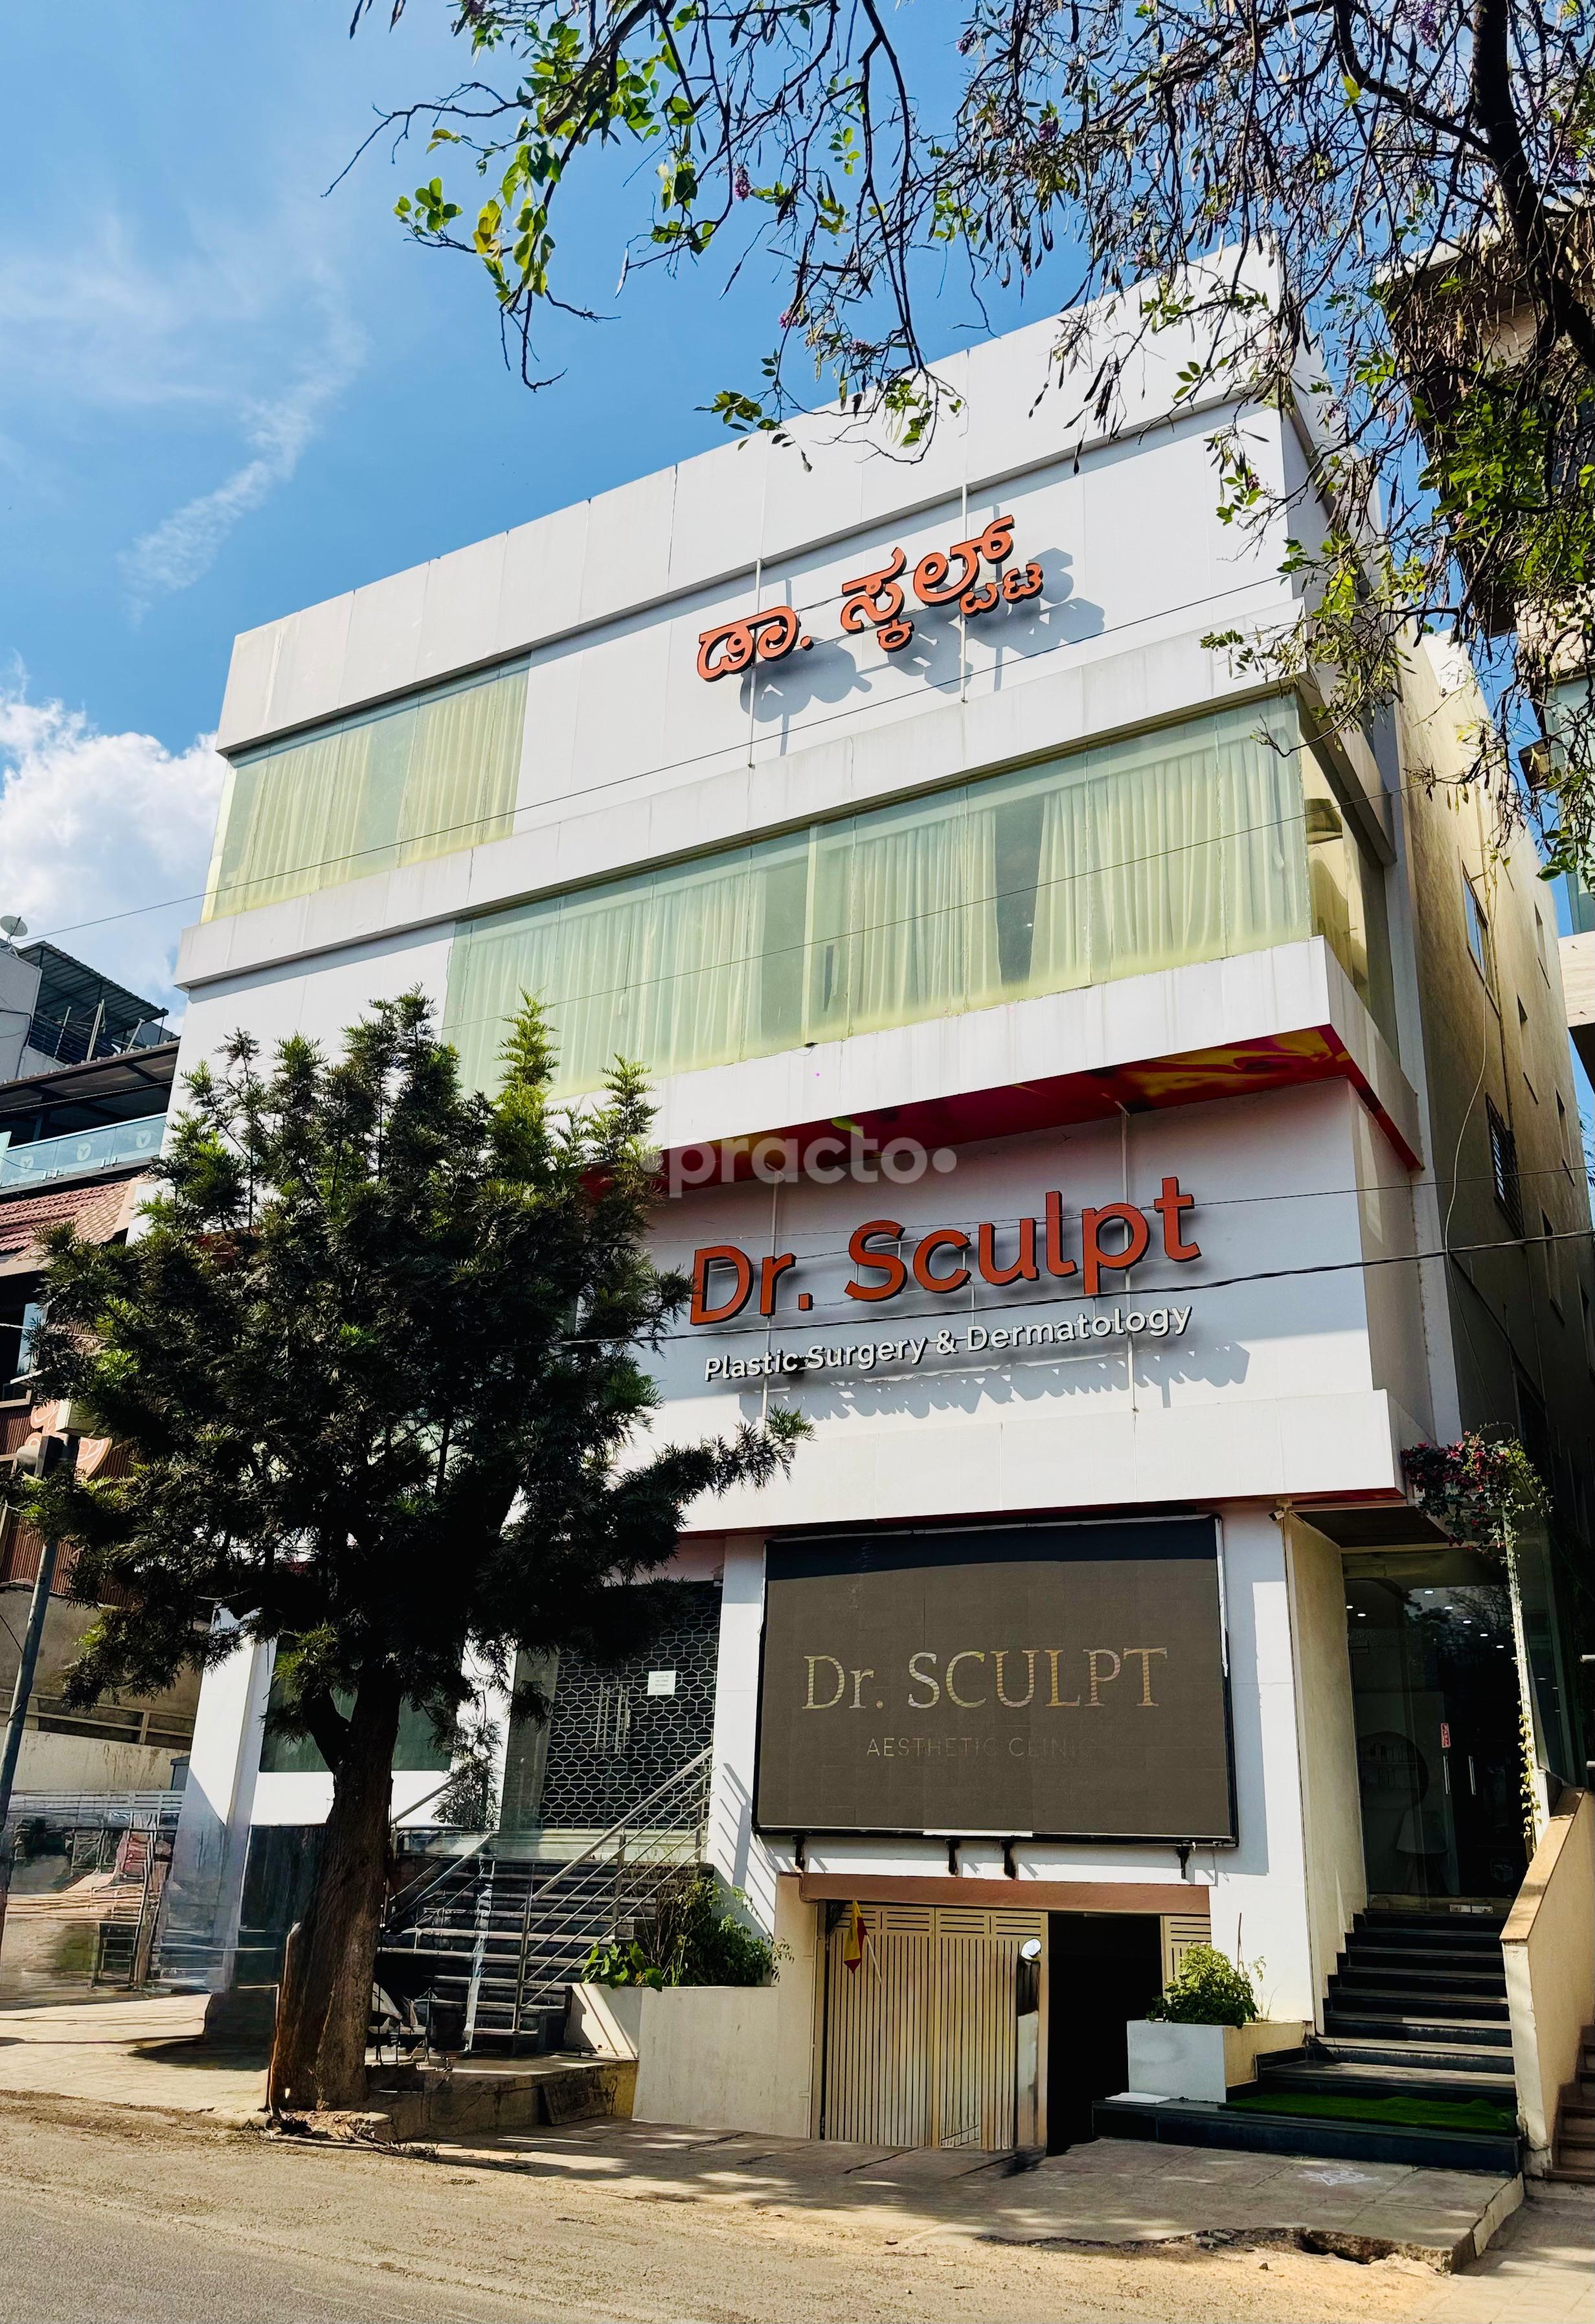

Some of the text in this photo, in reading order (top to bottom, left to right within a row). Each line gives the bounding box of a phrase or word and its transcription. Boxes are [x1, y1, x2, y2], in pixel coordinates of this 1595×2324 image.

[697, 605, 813, 682] ಡಾ.
[690, 1177, 1201, 1326] Dr. Sculpt
[704, 1305, 1192, 1382] Plastic Surgery & Dermatology
[802, 1647, 1168, 1709] Dr. SCULPT
[866, 1737, 999, 1757] AESTHETIC
